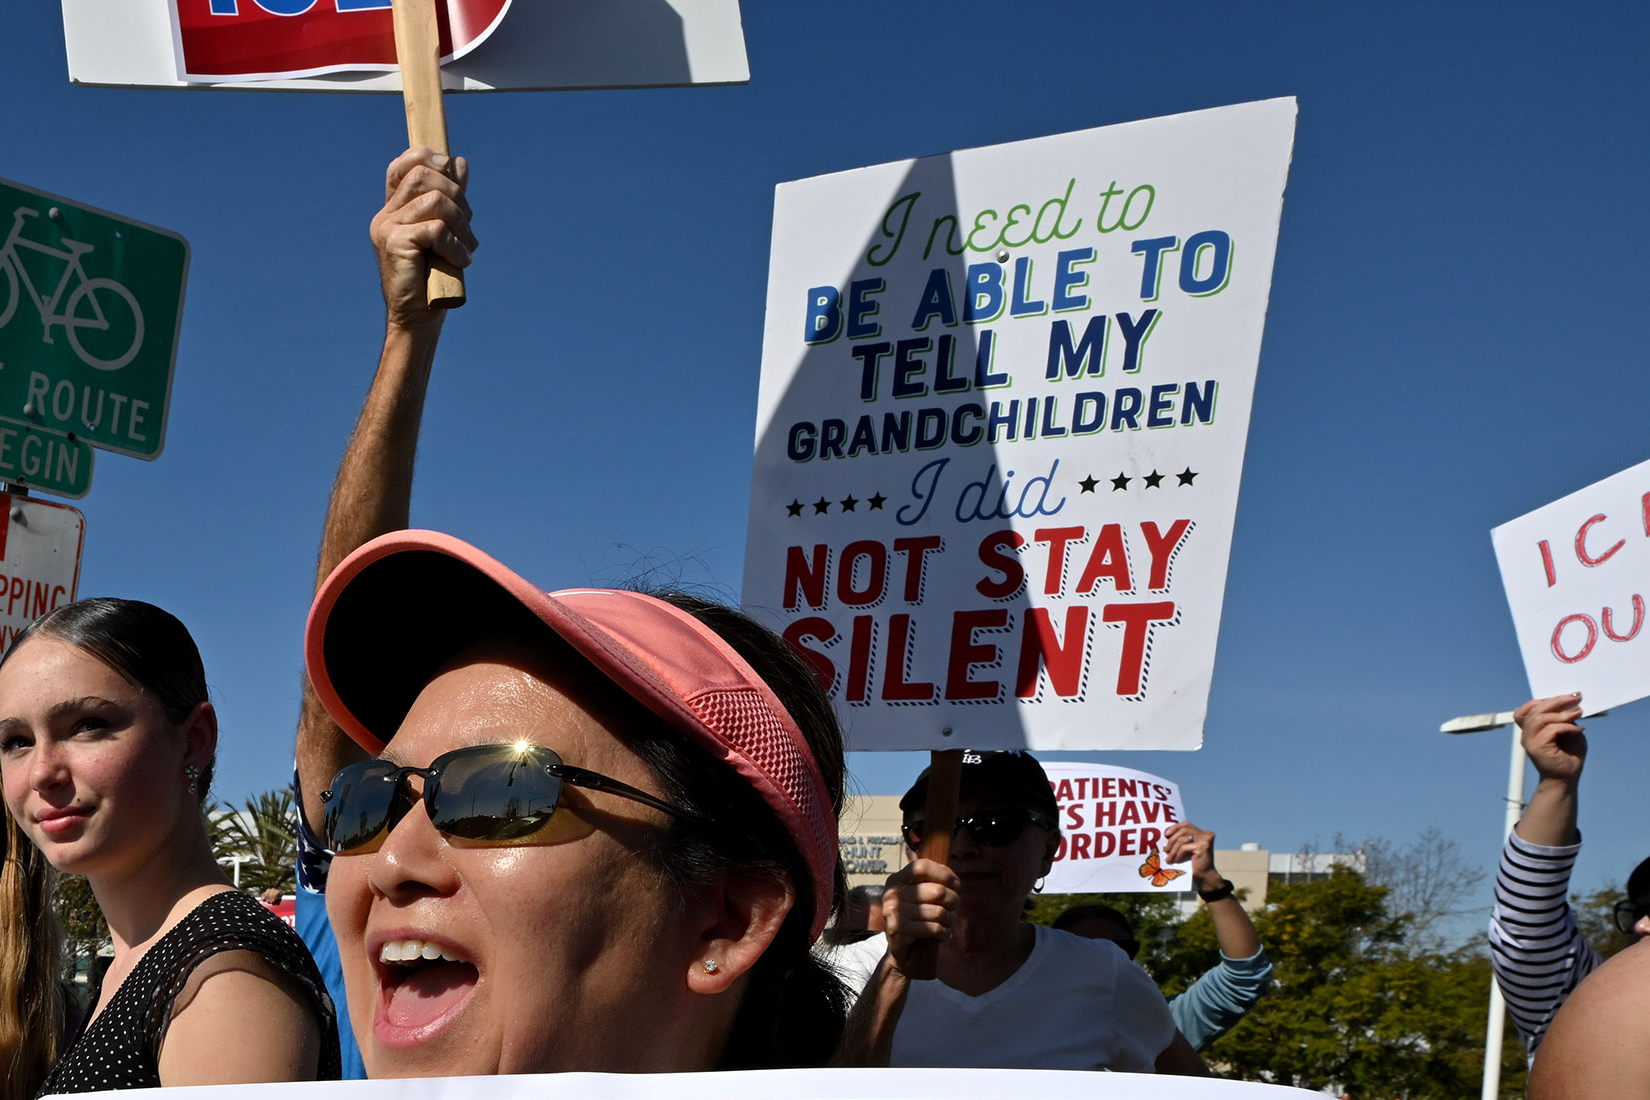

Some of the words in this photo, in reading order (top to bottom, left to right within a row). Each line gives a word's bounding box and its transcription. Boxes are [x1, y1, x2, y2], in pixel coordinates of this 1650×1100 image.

[866, 191, 922, 267] I
[922, 177, 1083, 262] need
[1096, 180, 1156, 234] to
[803, 277, 885, 345] BE
[911, 246, 1097, 330] ABLE
[1130, 229, 1235, 302] TO
[851, 329, 1012, 402] TELL
[1045, 308, 1163, 382] MY
[27, 371, 150, 442] ROUTE
[786, 380, 1219, 463] GRANDCHILDREN
[895, 458, 951, 526] I
[955, 458, 1067, 524] did
[783, 535, 946, 613] NOT
[975, 518, 1197, 602] STAY
[1536, 491, 1650, 588] IC
[781, 601, 1182, 708] SILENT
[1551, 594, 1646, 664] OU
[845, 846, 882, 859] HUNT
[1053, 827, 1166, 862] ORDER
[1095, 800, 1180, 828] HAVE
